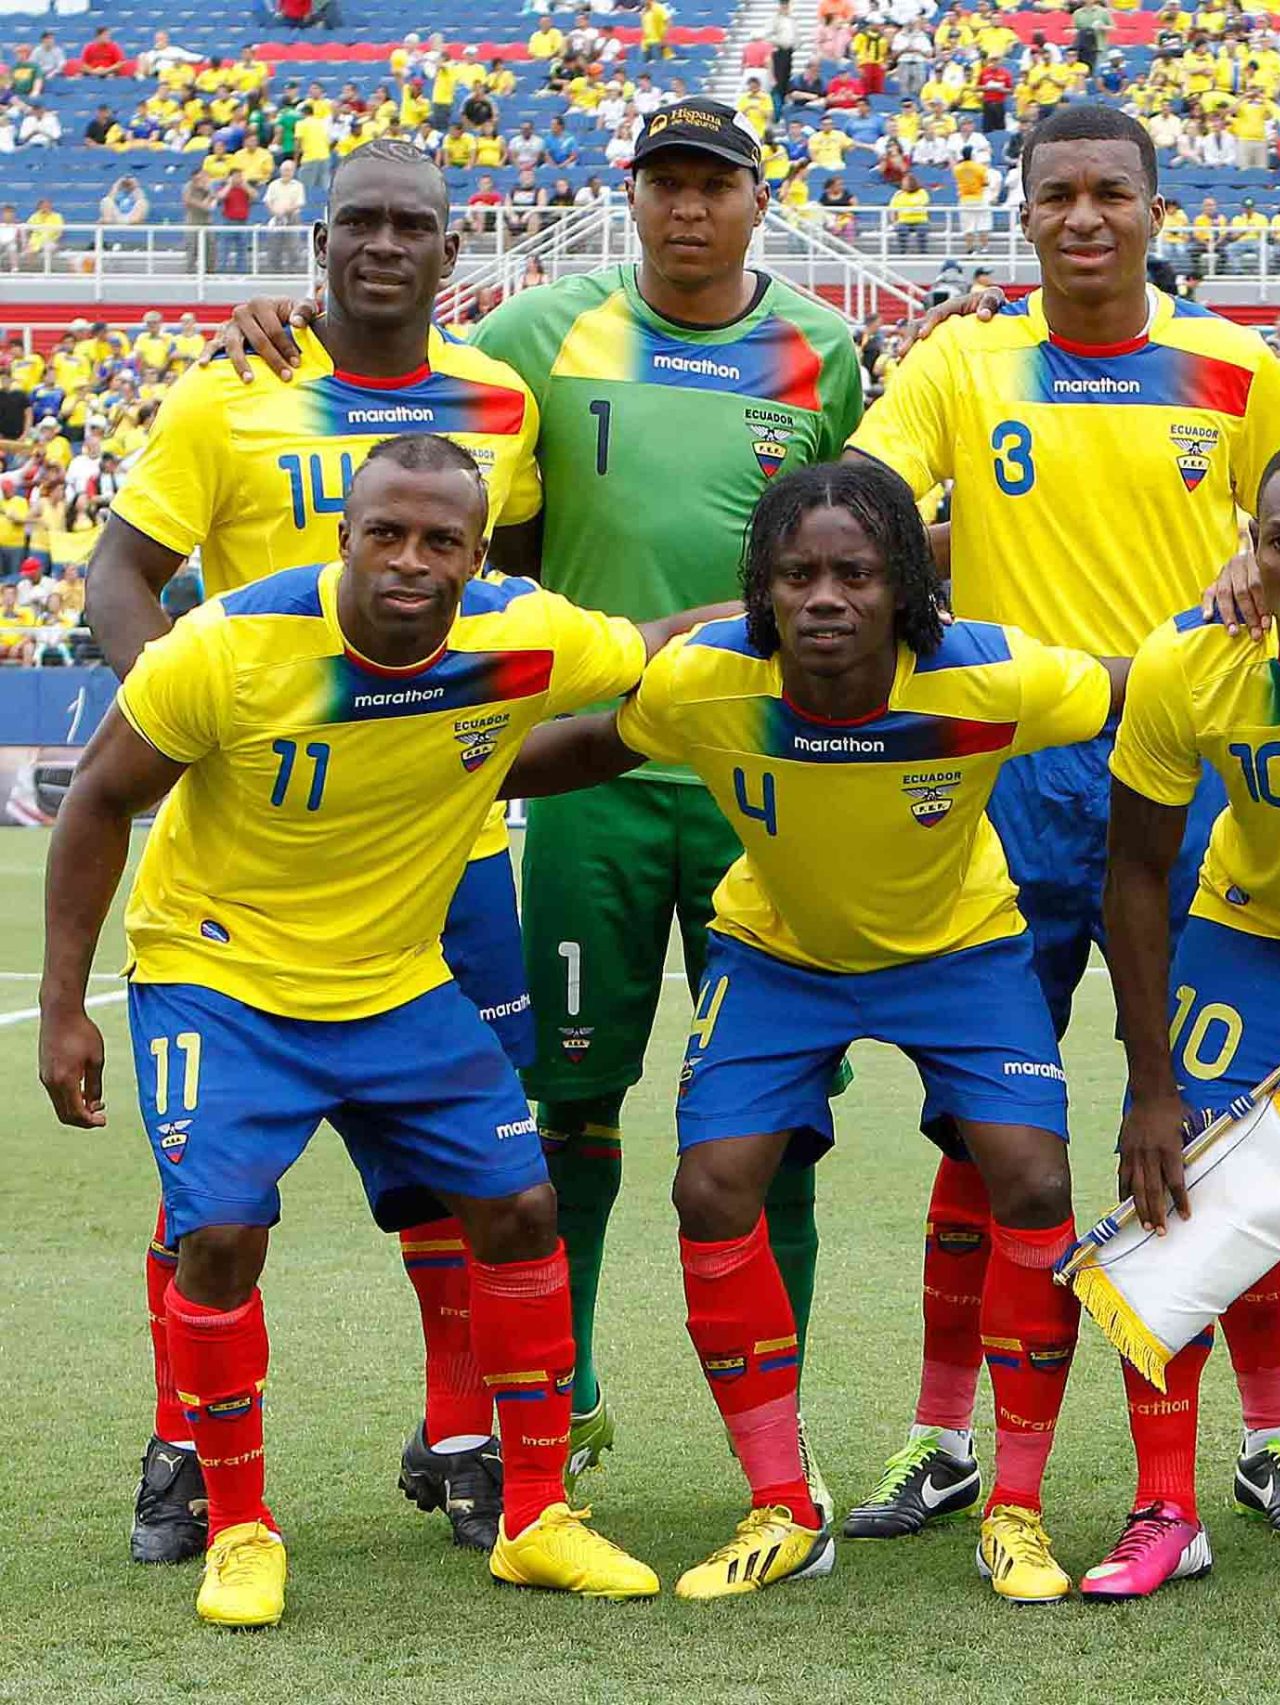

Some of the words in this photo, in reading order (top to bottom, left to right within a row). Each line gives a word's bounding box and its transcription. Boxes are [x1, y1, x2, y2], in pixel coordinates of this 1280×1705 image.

[671, 108, 721, 126] Hispana
[653, 354, 740, 380] marathon
[1053, 376, 1141, 393] marathon
[348, 405, 434, 424] marathon
[745, 409, 794, 427] ECUADOR
[589, 400, 610, 475] 1
[1170, 424, 1219, 440] ECUADOR
[991, 419, 1035, 496] 3
[278, 452, 352, 530] 14
[354, 685, 445, 708] marathon
[454, 712, 511, 732] ECUADOR
[794, 735, 885, 753] marathon
[270, 739, 331, 812] 11
[903, 771, 962, 785] ECUADOR
[733, 766, 778, 836] 4
[558, 941, 580, 1016] 1
[690, 975, 728, 1049] 4
[1168, 984, 1244, 1081] 10
[150, 1032, 201, 1115] 11
